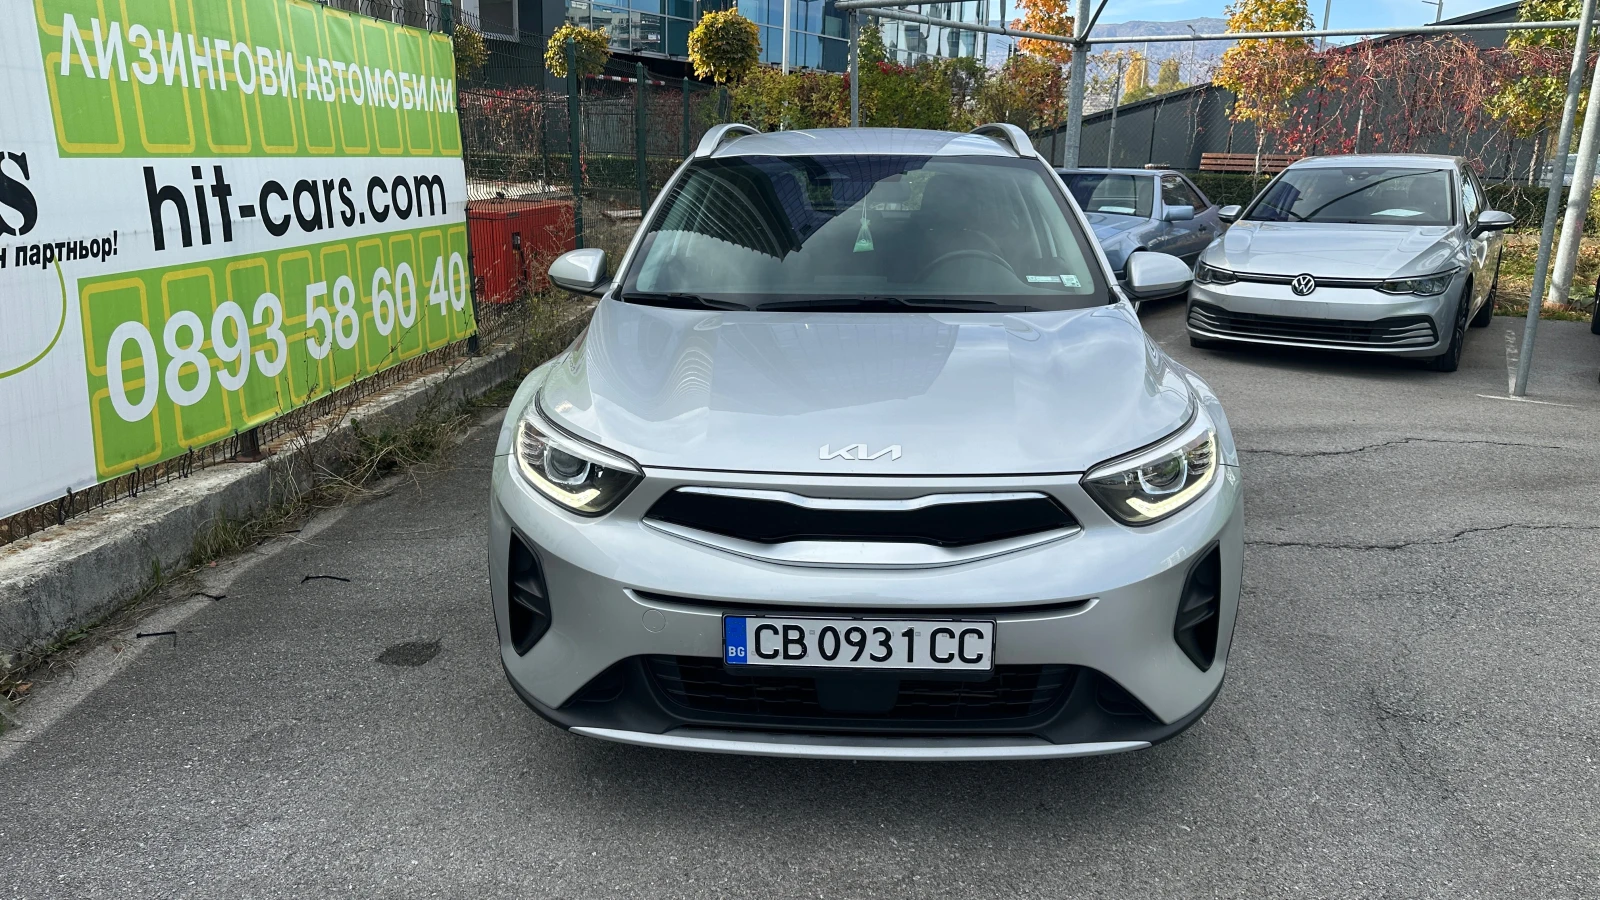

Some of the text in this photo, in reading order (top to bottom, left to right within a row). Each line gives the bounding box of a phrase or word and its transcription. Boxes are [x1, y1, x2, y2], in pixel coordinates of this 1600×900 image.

[60, 13, 454, 114] ЛИЗИНГОВИ АВТОМОБИЛИ
[143, 164, 447, 251] hit-cars.com
[15, 230, 118, 270] партньор!
[106, 251, 466, 422] 0893 58 60 40
[819, 443, 902, 461] KIA
[728, 645, 746, 657] BG
[818, 625, 915, 662] 0931
[929, 627, 985, 664] CC
